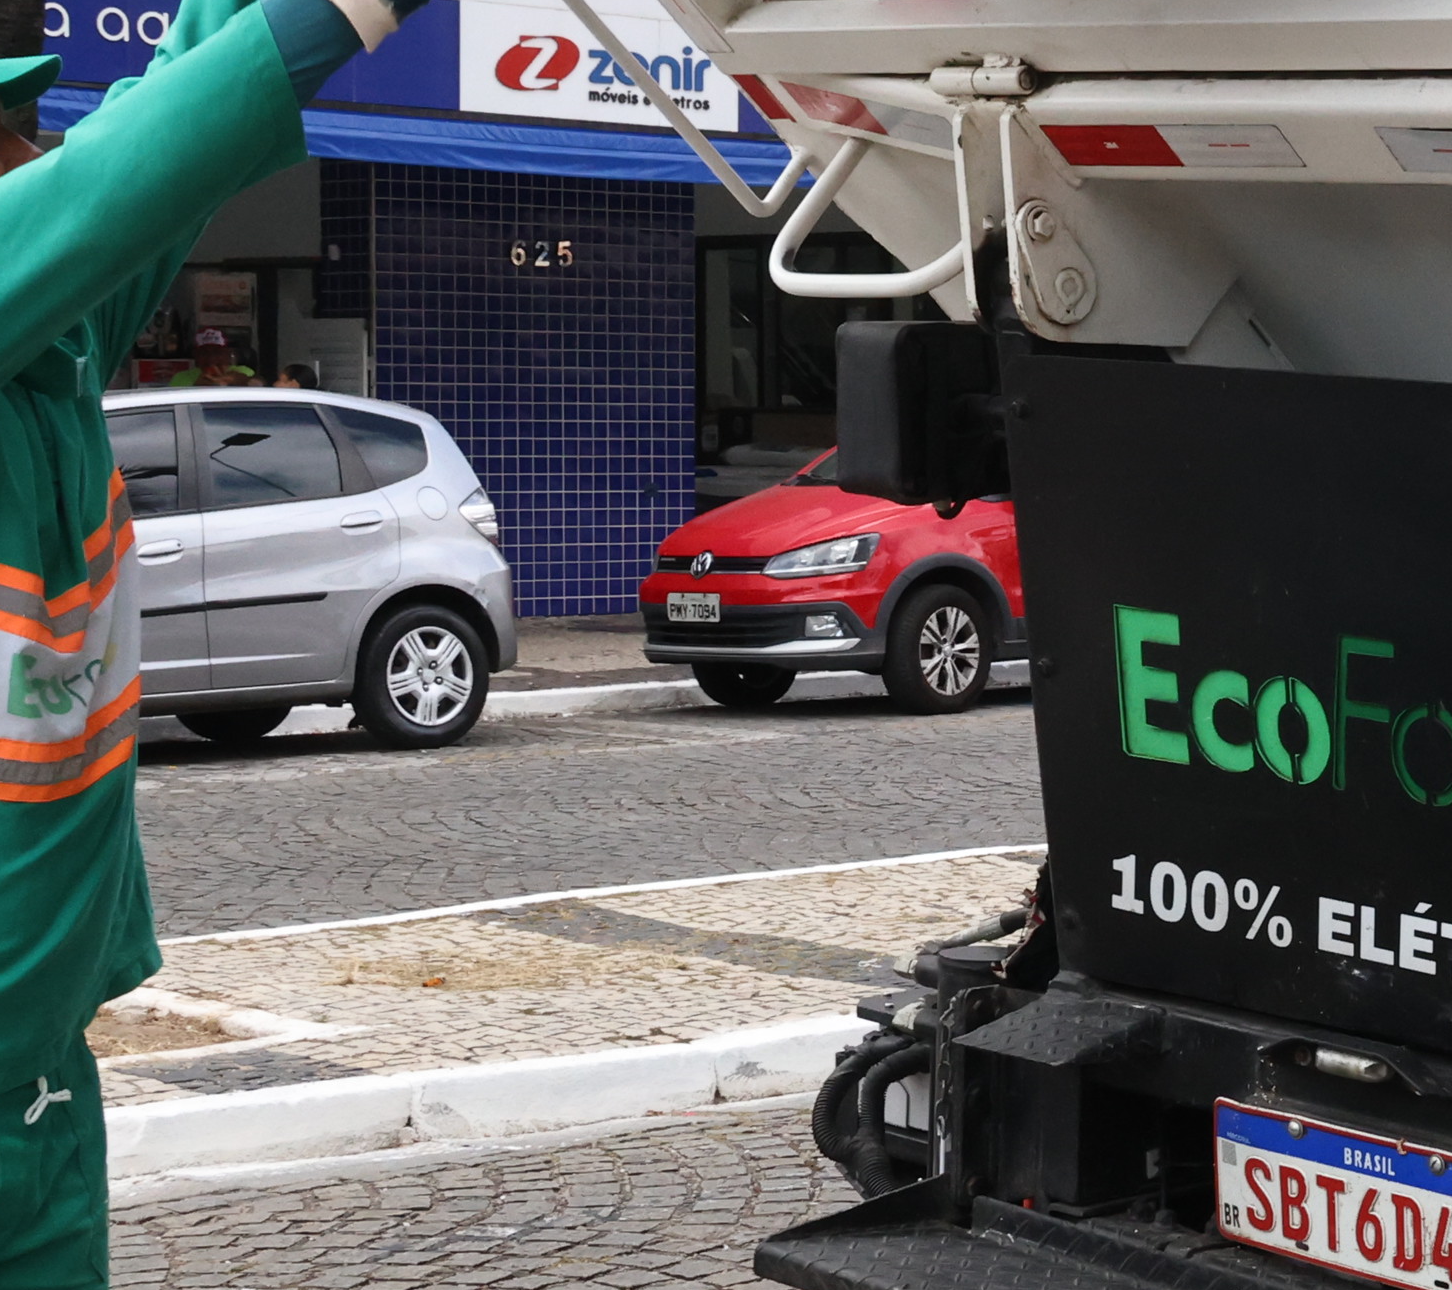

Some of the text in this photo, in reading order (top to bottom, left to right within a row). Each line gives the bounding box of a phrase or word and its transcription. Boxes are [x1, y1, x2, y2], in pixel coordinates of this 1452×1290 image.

[588, 87, 639, 106] móveis
[510, 240, 573, 267] 625
[1111, 854, 1294, 948] 100%
[1343, 1146, 1397, 1177] BRASIL
[1223, 1202, 1242, 1229] BR
